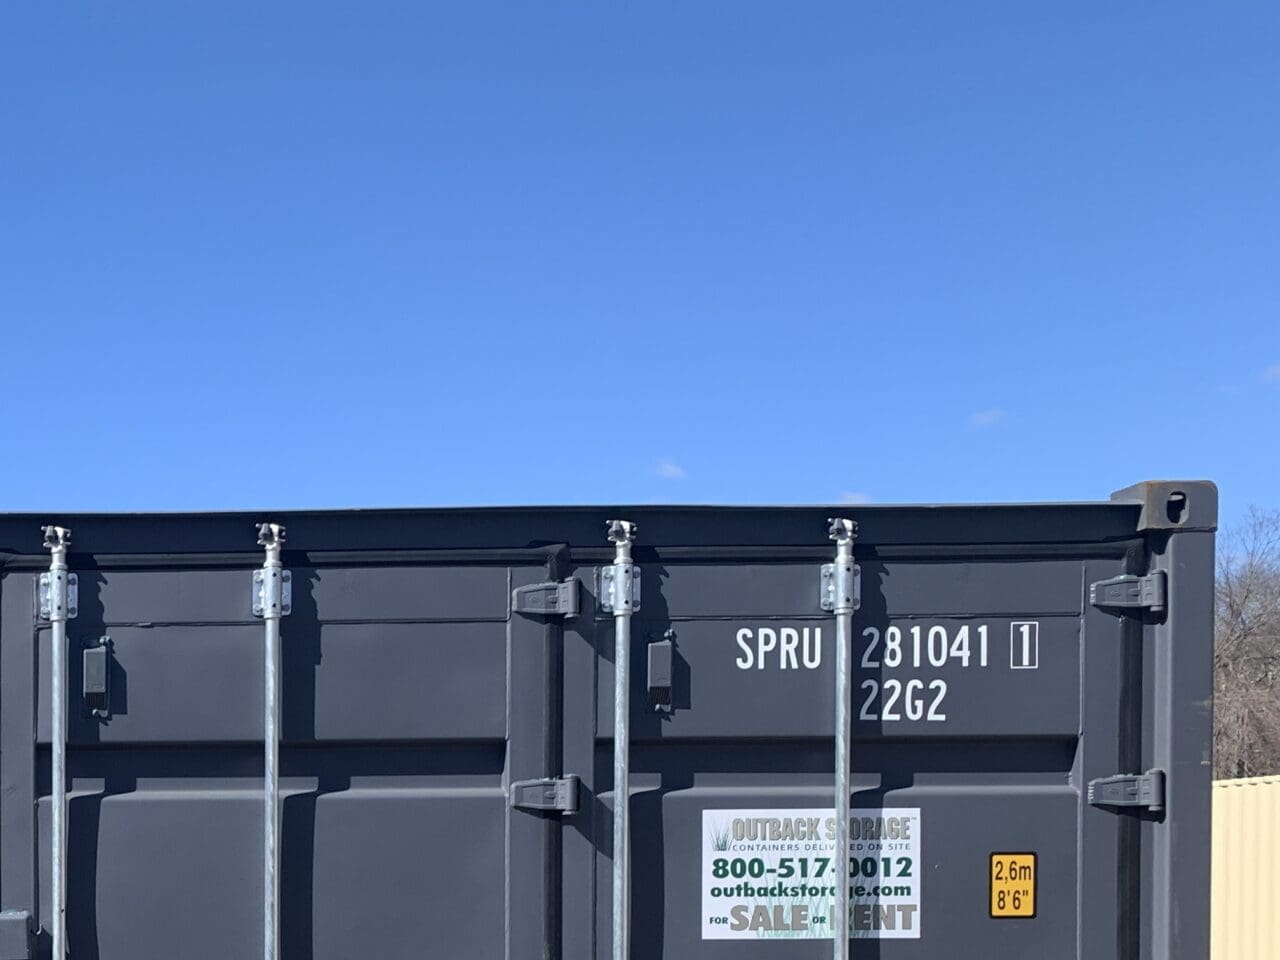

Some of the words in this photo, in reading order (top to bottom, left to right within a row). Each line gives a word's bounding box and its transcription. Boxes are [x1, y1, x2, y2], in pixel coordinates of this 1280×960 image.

[735, 627, 822, 669] SPRU
[860, 625, 988, 668] 281041
[859, 679, 948, 721] 22G2
[732, 817, 821, 841] OUTBACK
[825, 816, 911, 840] SORAGE
[732, 843, 799, 852] CONTAINERS
[804, 843, 863, 851] DELIVED
[867, 843, 883, 851] ON
[995, 860, 1032, 884] 2,6m
[709, 916, 728, 925] FOR
[729, 904, 809, 931] SALE
[812, 916, 826, 924] OR
